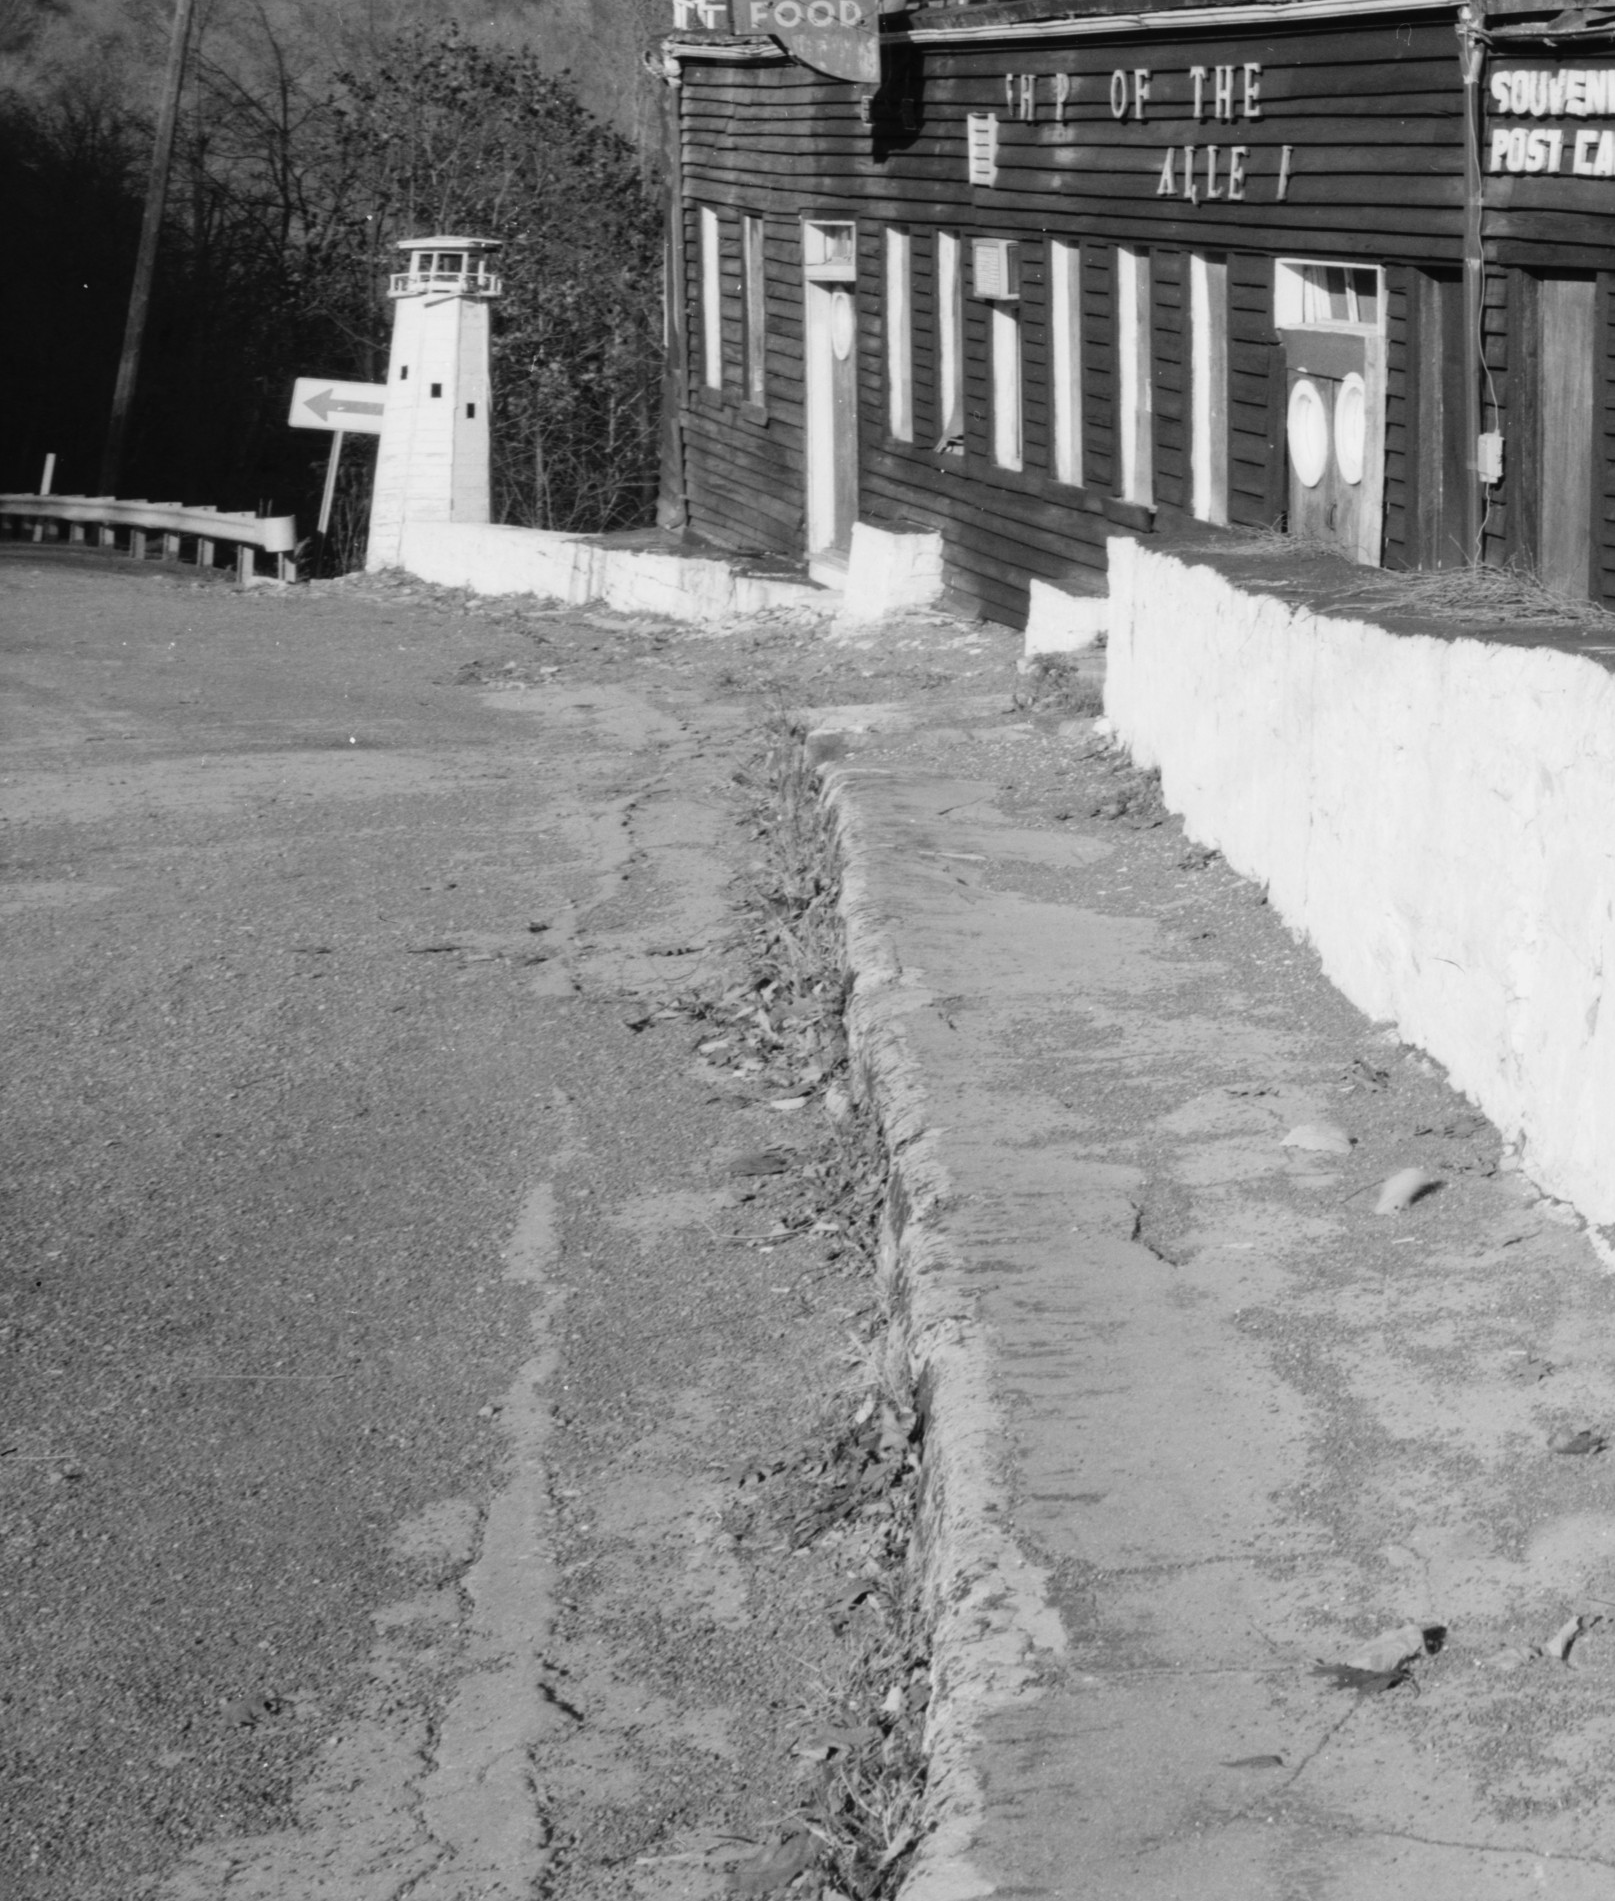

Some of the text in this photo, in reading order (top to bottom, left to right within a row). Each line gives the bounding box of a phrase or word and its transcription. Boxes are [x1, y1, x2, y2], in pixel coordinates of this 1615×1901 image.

[750, 0, 862, 28] FOOD
[1110, 68, 1151, 120] OF
[1190, 62, 1262, 119] THE
[1489, 127, 1563, 175] POST
